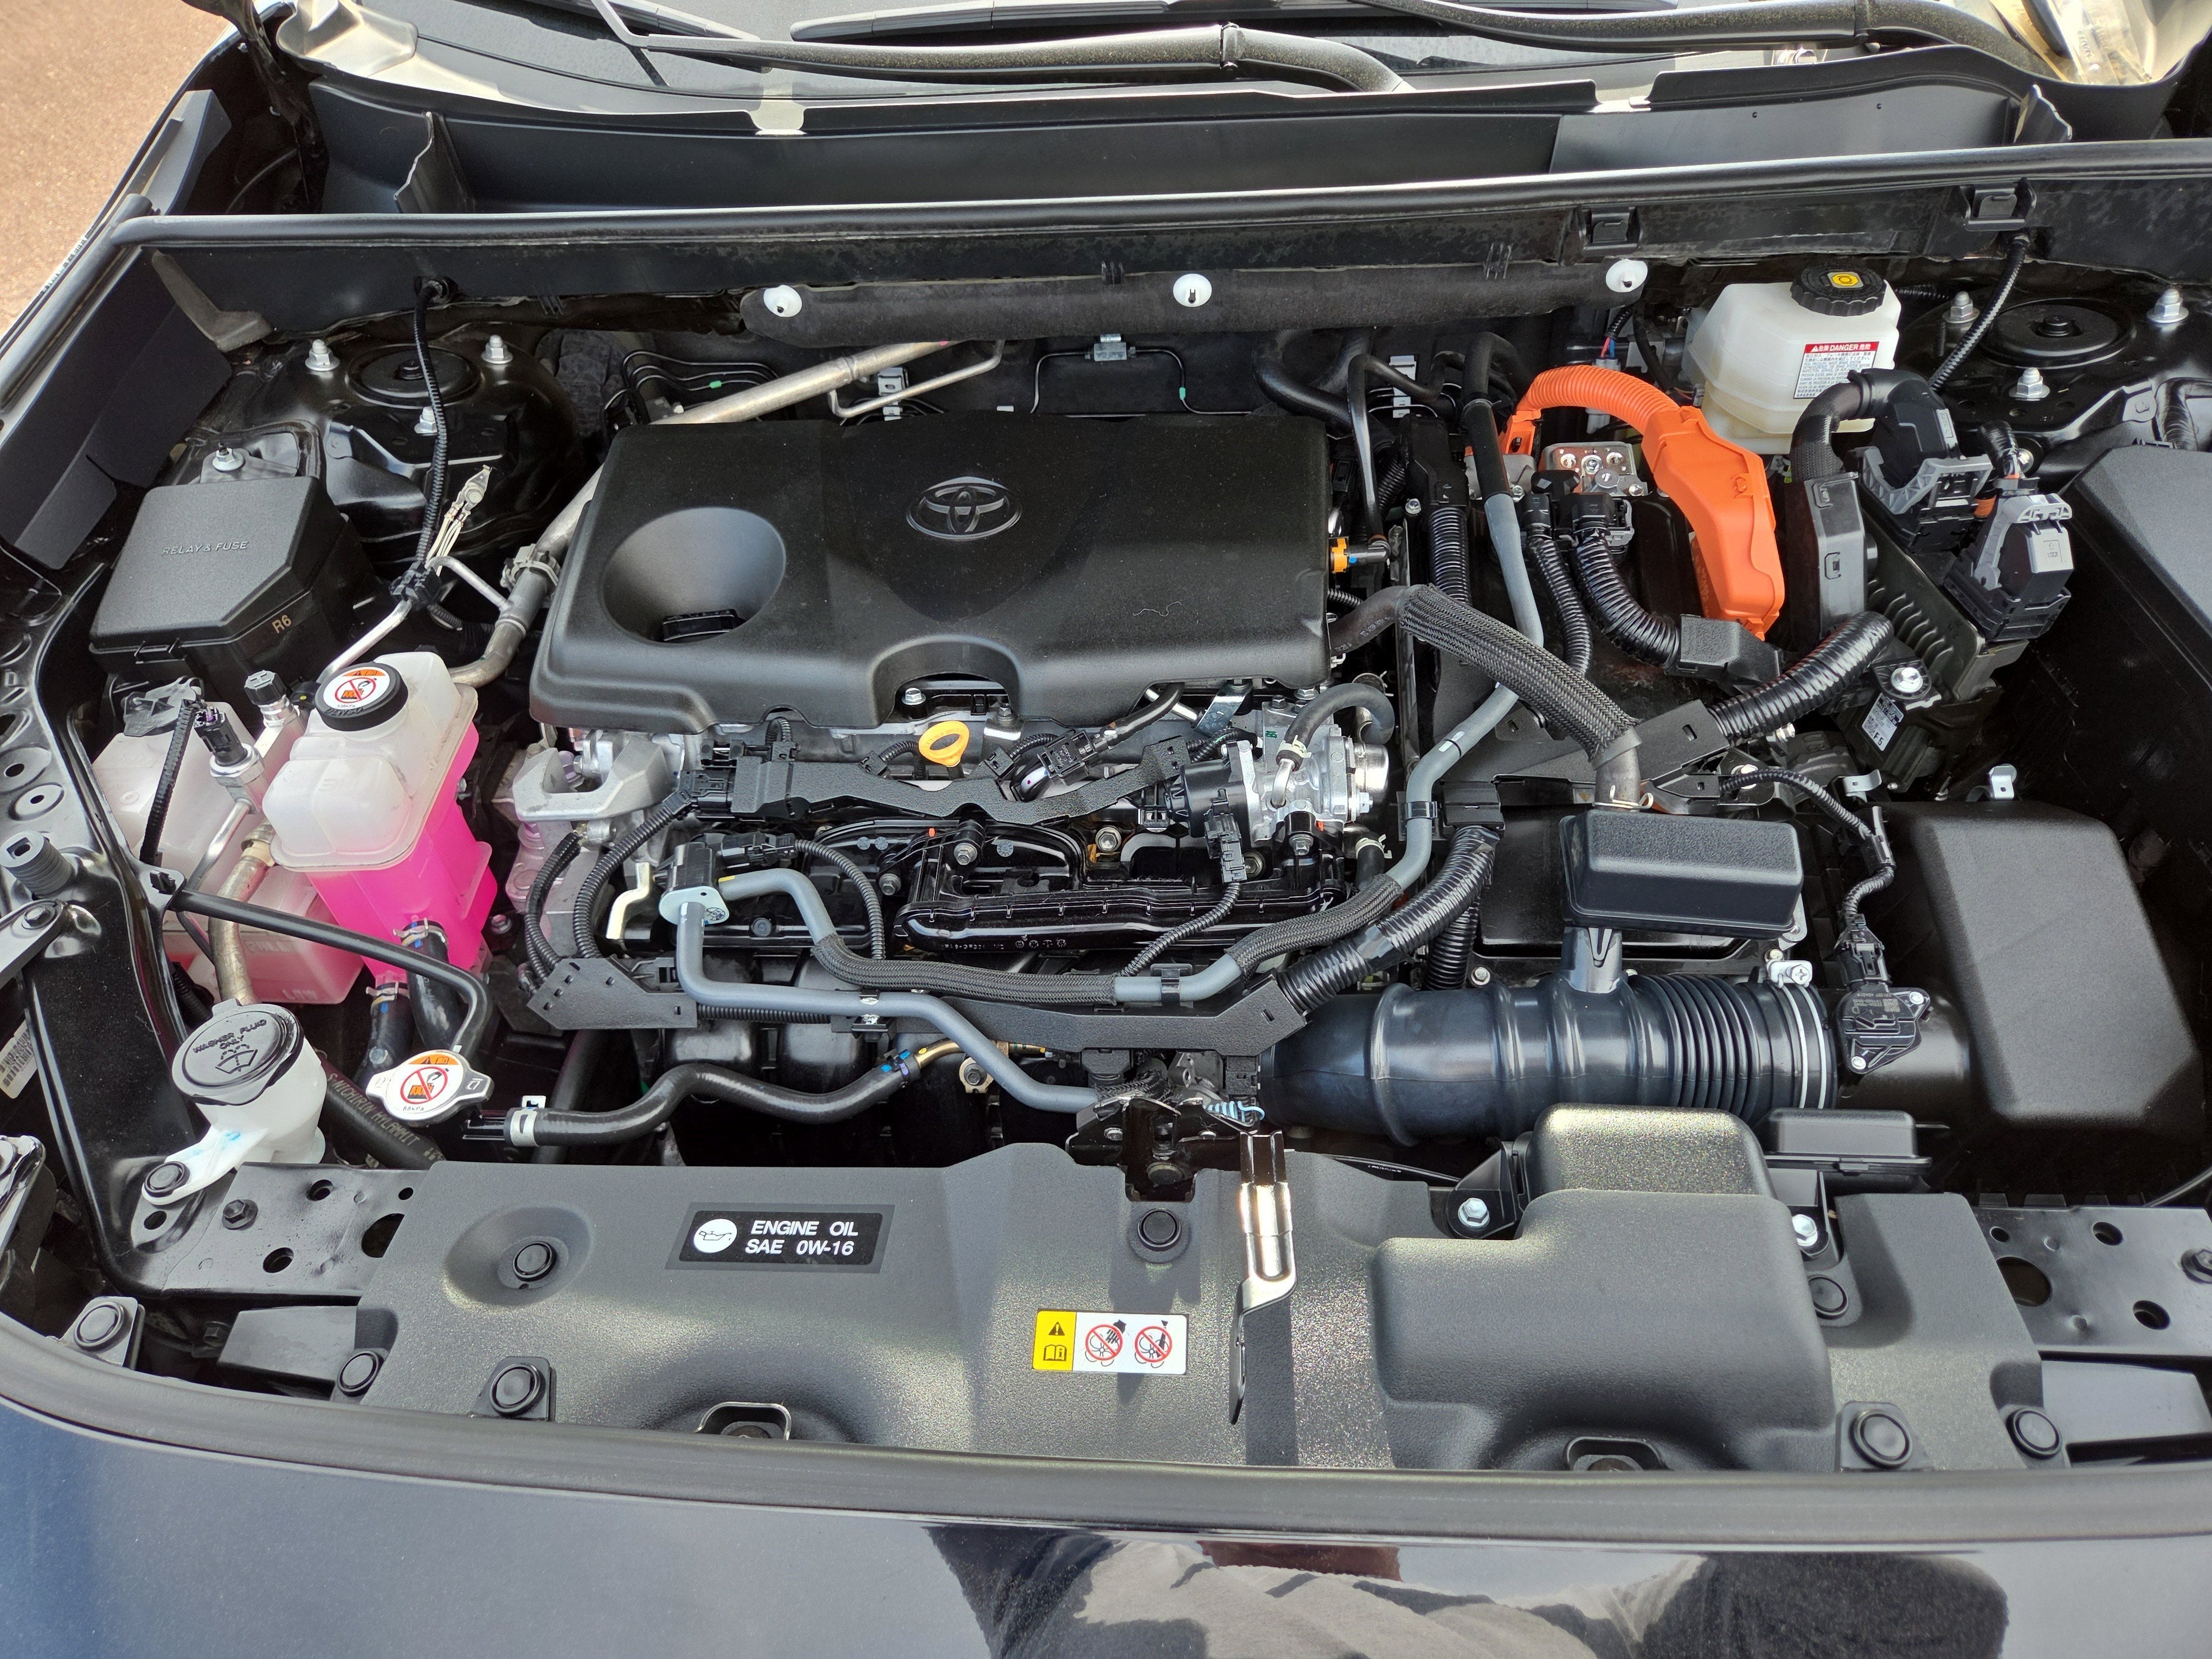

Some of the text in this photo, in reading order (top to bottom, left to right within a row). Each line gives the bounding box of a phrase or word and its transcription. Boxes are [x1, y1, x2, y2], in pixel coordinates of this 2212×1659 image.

[162, 543, 203, 555] RELAY
[215, 541, 249, 551] FUSE
[272, 614, 292, 634] R6
[326, 706, 364, 717] DENSO
[192, 1019, 267, 1053] WASHER FLUID
[220, 1034, 244, 1050] ONLY
[750, 1220, 859, 1237] ENGINE OIL
[744, 1238, 855, 1256] SAE 0W-16
